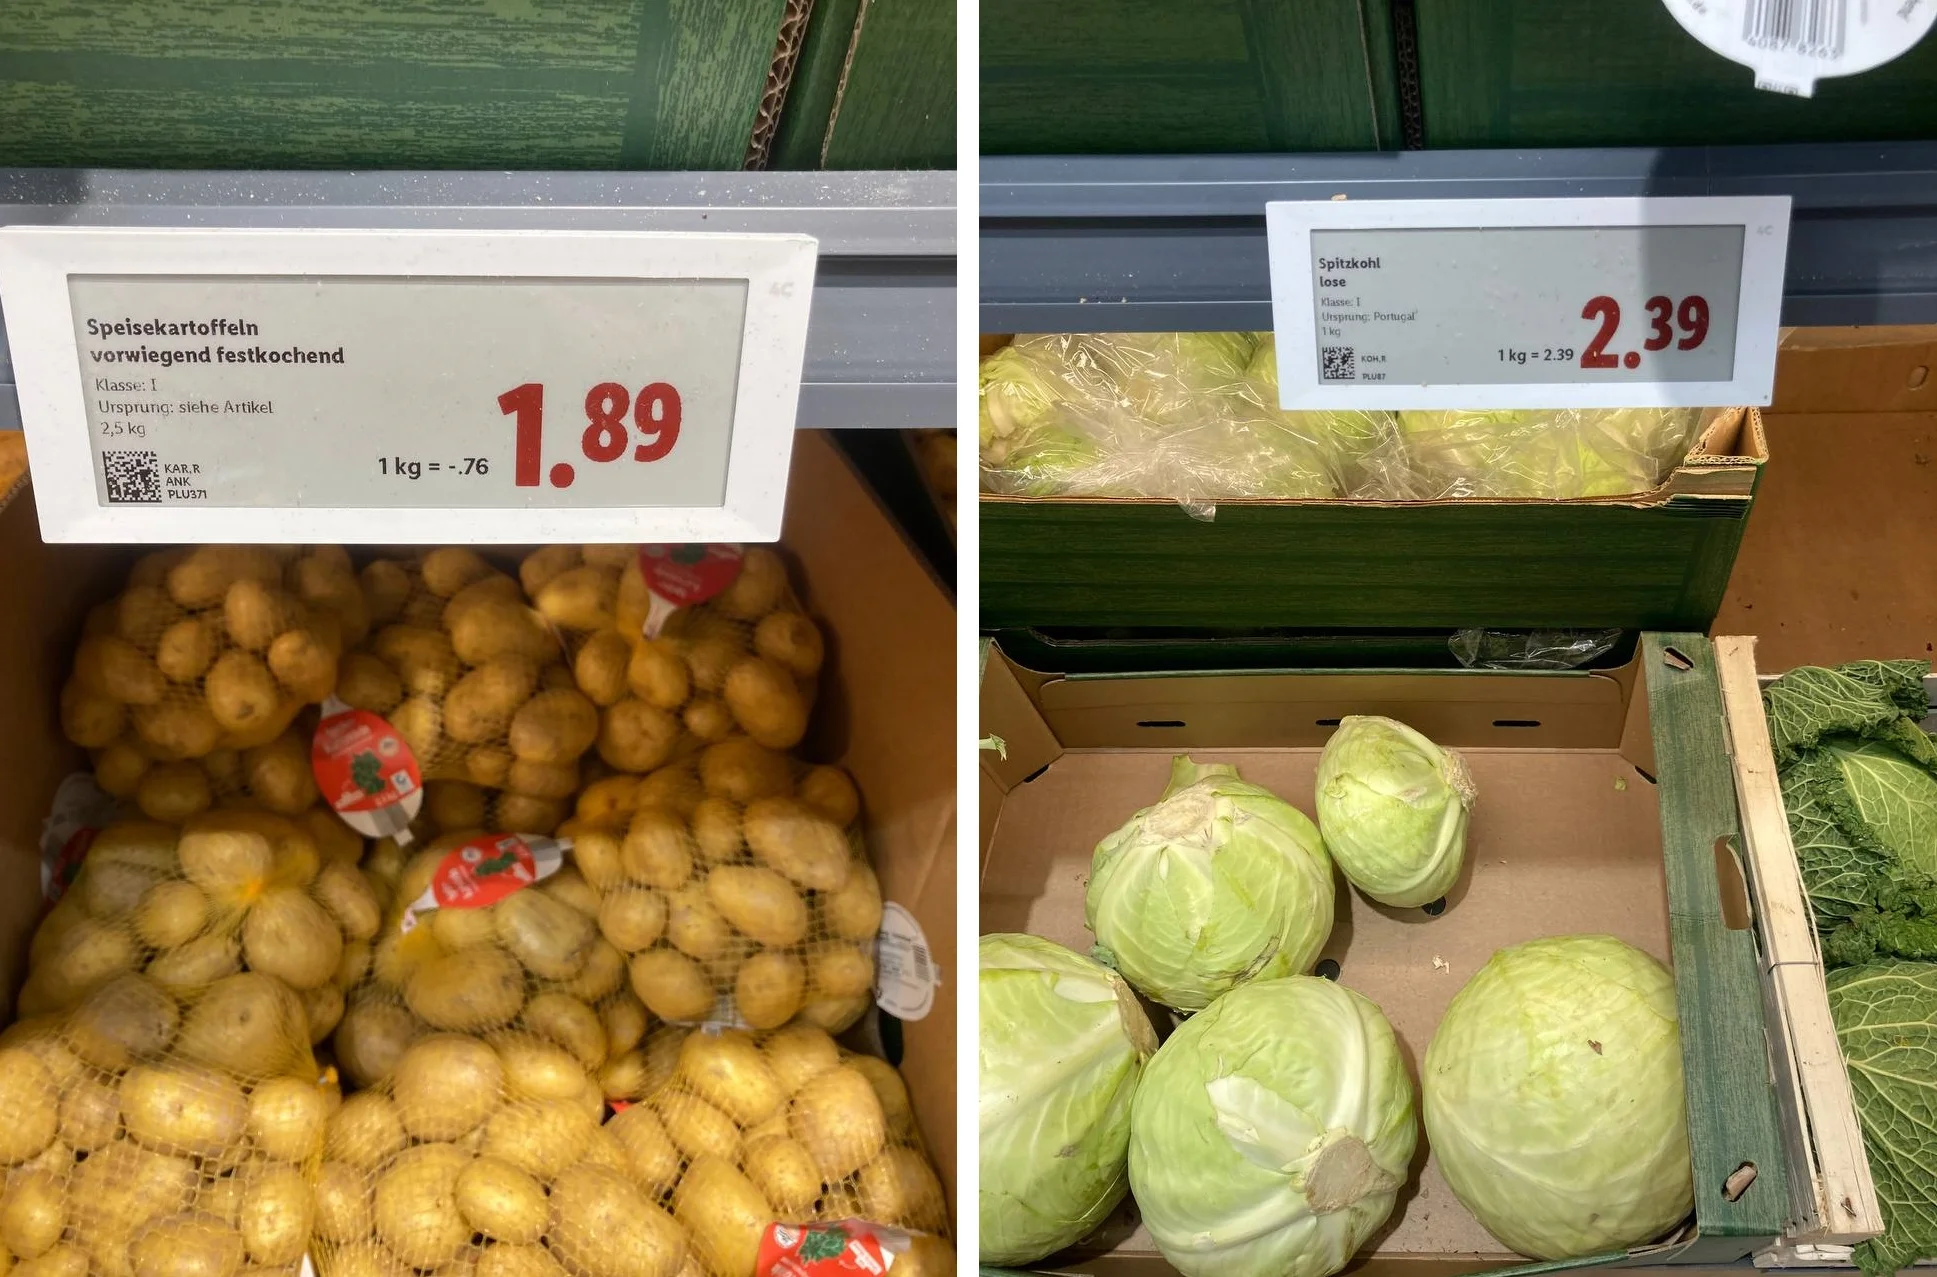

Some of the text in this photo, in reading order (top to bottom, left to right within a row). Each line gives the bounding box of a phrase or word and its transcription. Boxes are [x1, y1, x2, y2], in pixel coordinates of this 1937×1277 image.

[1318, 257, 1381, 272] Spitzkohl
[1319, 276, 1347, 287] lose
[1356, 297, 1361, 307] I
[1321, 312, 1416, 323] Ursprung: Portugal
[86, 317, 259, 340] Speisekartoffeln
[1322, 326, 1341, 338] 1 kg
[1580, 295, 1710, 369] 2.39
[90, 345, 345, 368] vorwiegend festkochend
[1361, 355, 1386, 363] KOH.R
[1498, 349, 1505, 361] 1
[1509, 349, 1527, 364] kg
[1544, 349, 1574, 361] 2.39
[1362, 373, 1386, 381] PLU87
[95, 378, 157, 392] Klasse: I
[98, 400, 274, 417] Ursprung: siehe Artikel
[101, 422, 146, 437] 2,5 kg
[497, 381, 682, 488] 1.89
[164, 463, 200, 474] KAR.R
[378, 457, 489, 480] 1 kg = -.76
[166, 476, 191, 487] ANK
[168, 489, 207, 500] PLU371
